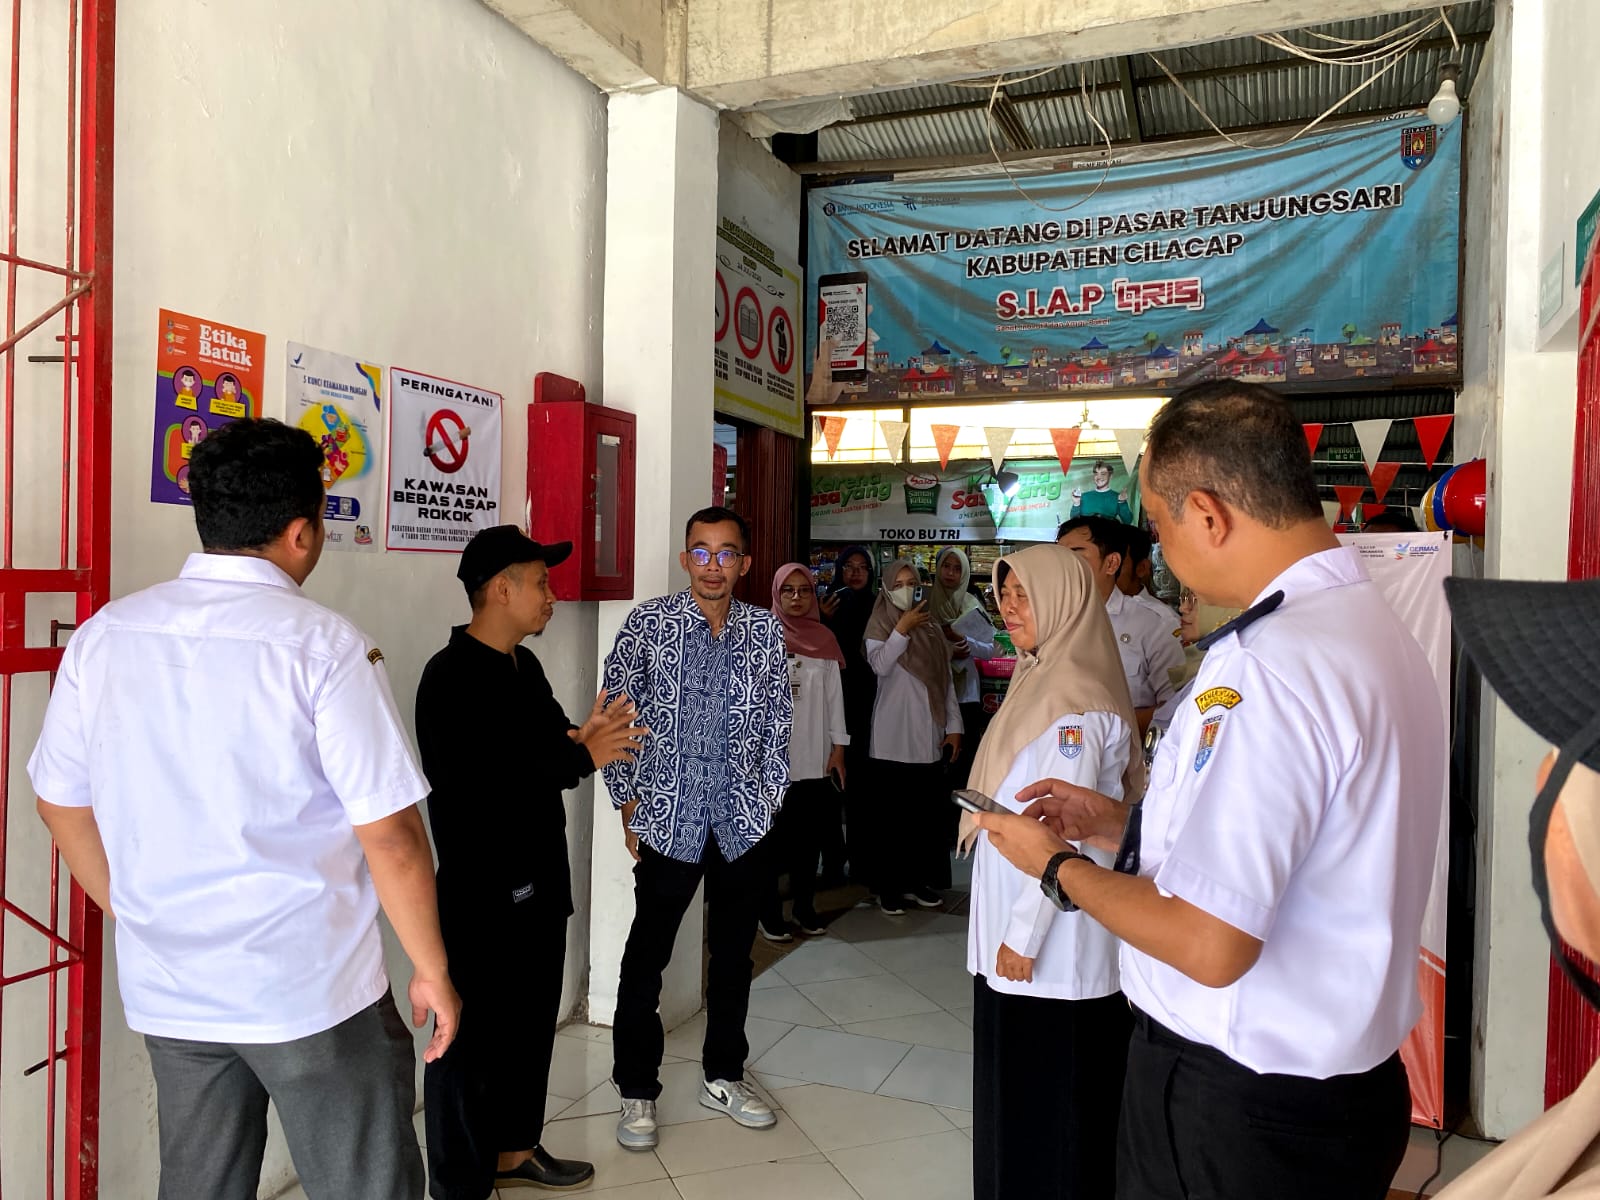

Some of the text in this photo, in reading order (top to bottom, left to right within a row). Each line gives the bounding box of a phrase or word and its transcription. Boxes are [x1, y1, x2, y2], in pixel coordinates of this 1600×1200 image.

[847, 184, 1402, 258] SELAMAT DATANG DI PASAR TANJUNGSARI
[966, 234, 1243, 278] KABUPATEN CILACAP
[997, 284, 1104, 319] S.I.A.P
[199, 323, 247, 350] Etika
[199, 340, 252, 367] Batuk
[401, 378, 494, 407] PERINGATAN!
[393, 490, 497, 511] BEBAS ASAP
[405, 478, 488, 498] KAWASAN
[811, 480, 892, 508] asayang
[418, 507, 473, 523] ROKOK
[879, 528, 961, 540] TOKO BU TRI
